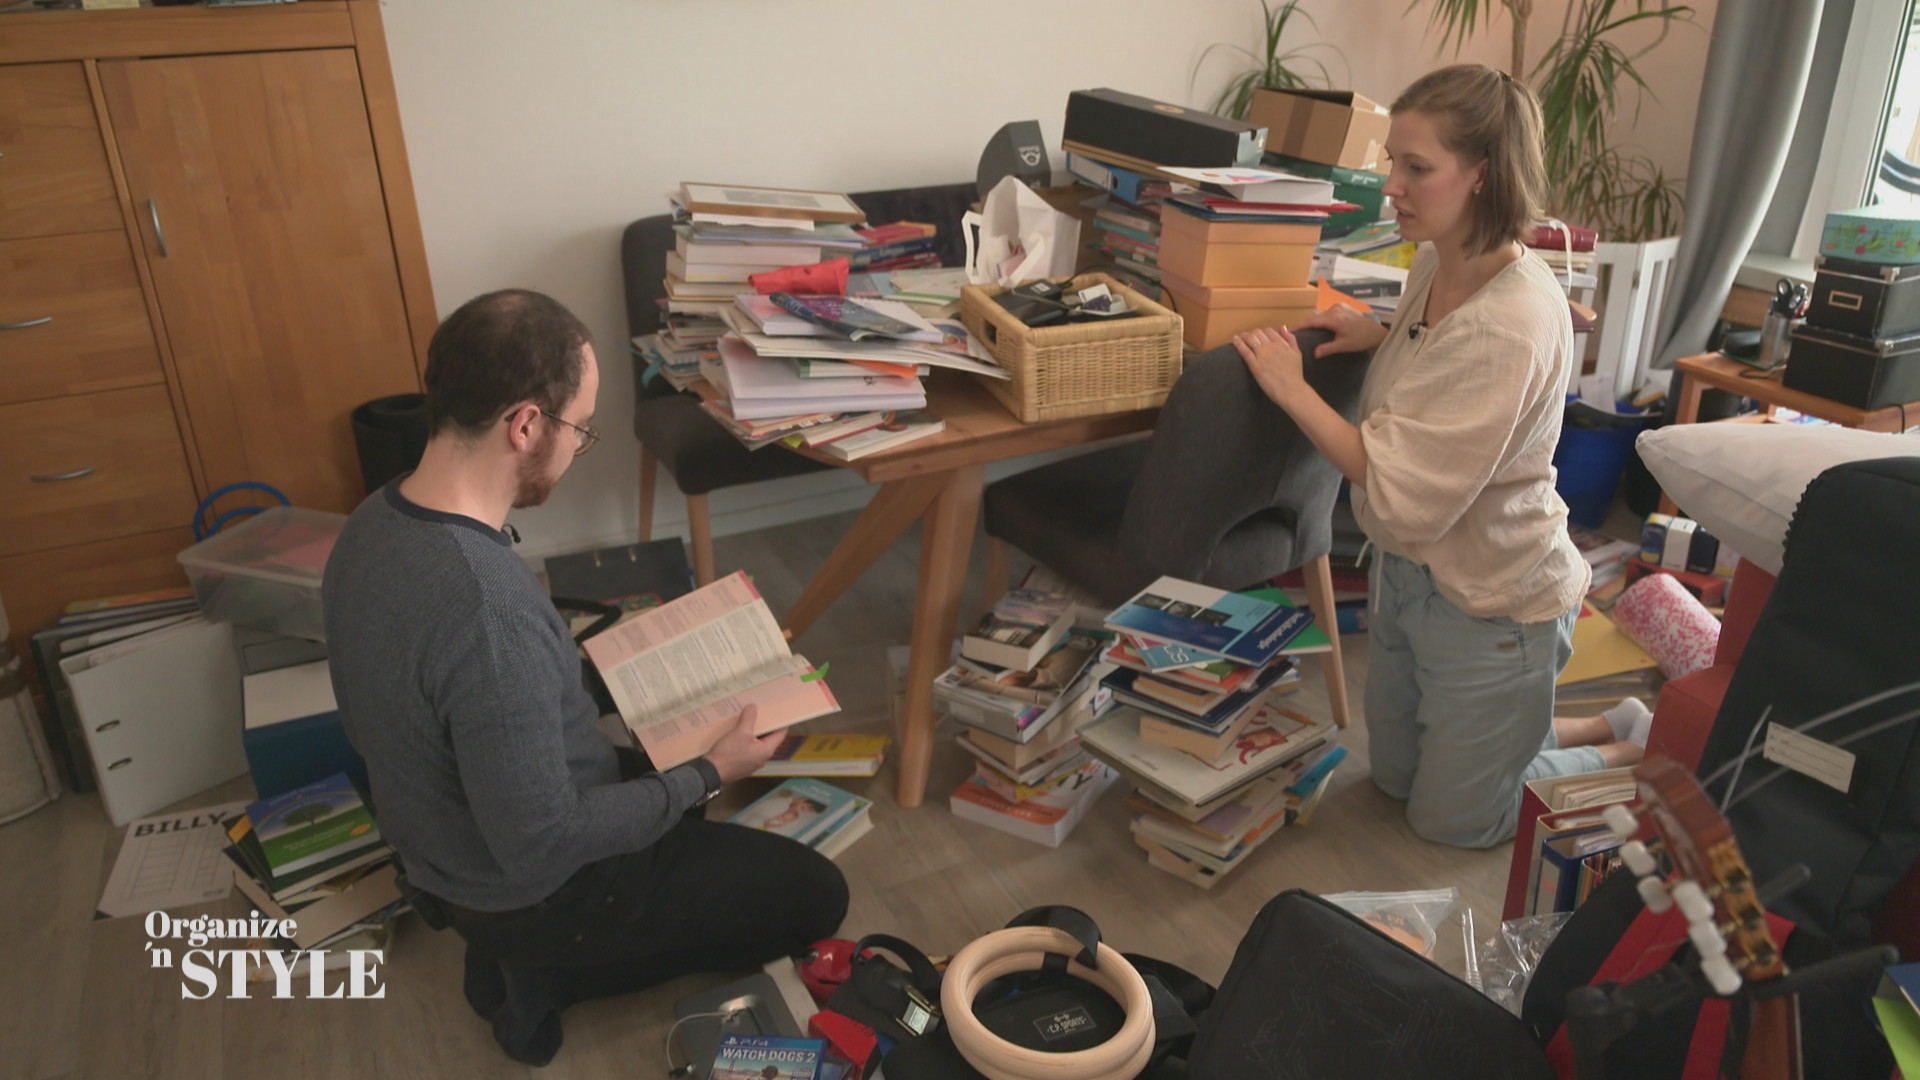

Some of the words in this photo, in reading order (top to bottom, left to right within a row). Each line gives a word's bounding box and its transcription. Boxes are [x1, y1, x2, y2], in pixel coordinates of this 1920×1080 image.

[134, 811, 228, 838] BILLY
[740, 1038, 769, 1046] PS4
[722, 1048, 766, 1061] WATCH
[768, 1050, 805, 1062] DOGS
[806, 1052, 816, 1063] 2
